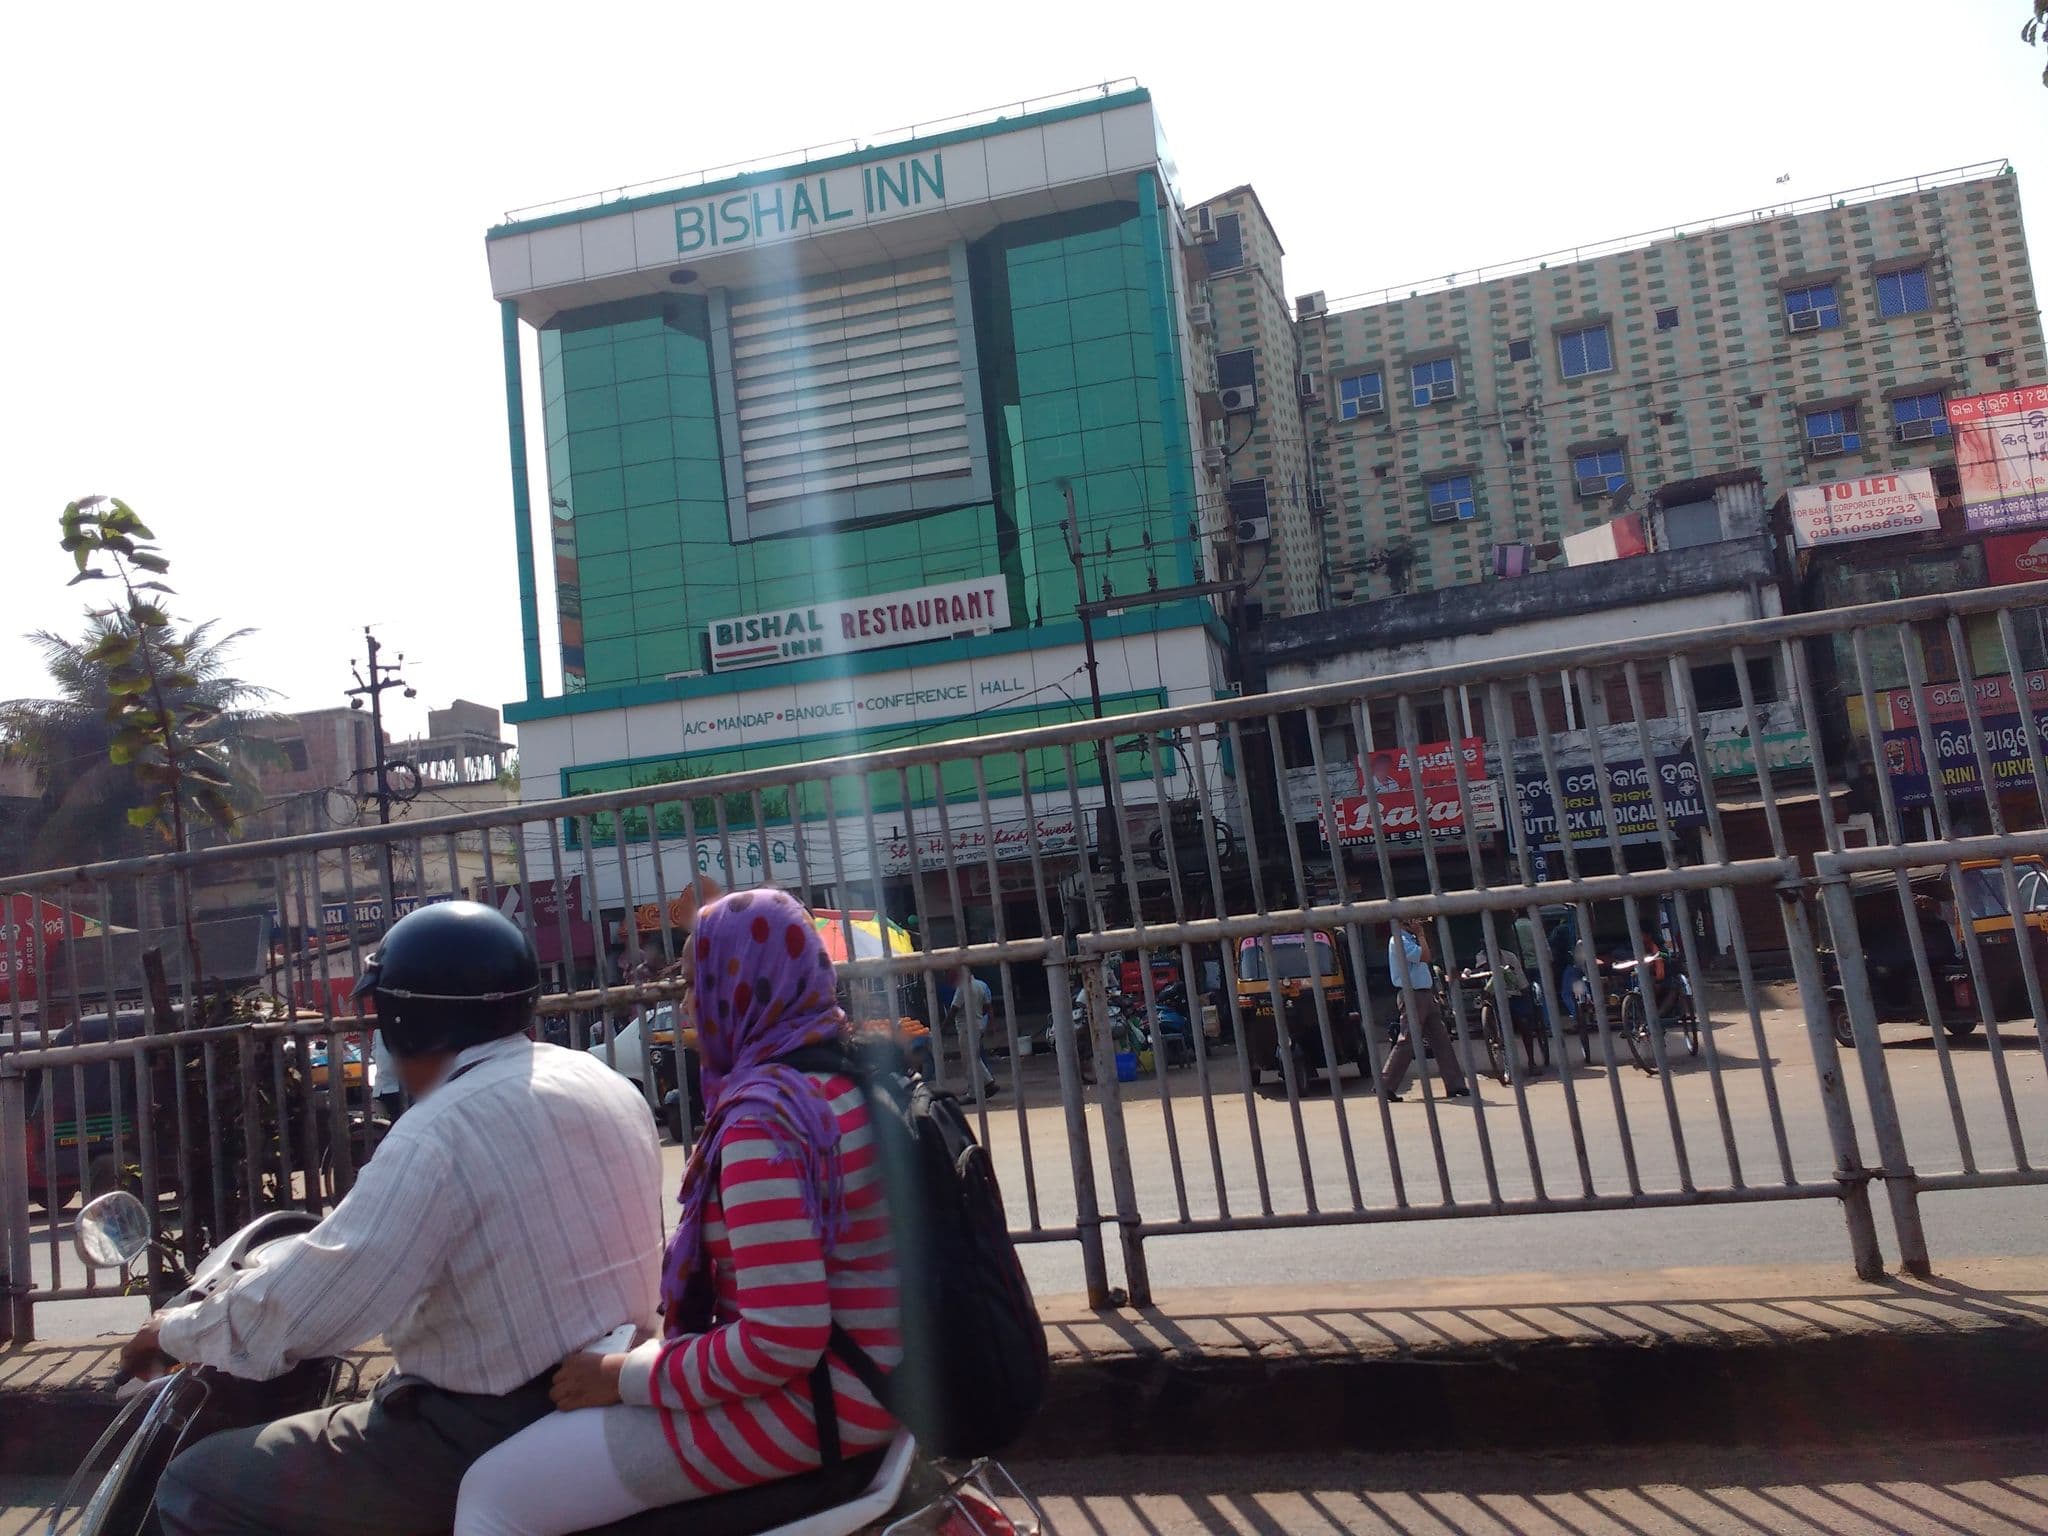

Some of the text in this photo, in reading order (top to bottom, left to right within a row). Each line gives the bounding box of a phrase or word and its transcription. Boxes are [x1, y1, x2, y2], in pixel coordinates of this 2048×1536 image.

[675, 153, 946, 253] BISHAL INN
[1819, 474, 1899, 502] TO LET
[1878, 495, 1903, 507] OFFICE
[1809, 515, 1924, 539] 09910588559
[1812, 503, 1917, 526] 9937133232
[715, 588, 996, 646] BISHAL RESTAURANT
[782, 637, 823, 657] INN
[716, 711, 774, 732] MANDAP
[785, 700, 854, 722] BANQUET
[865, 684, 969, 712] CONFERENCE
[981, 677, 1025, 695] HALL
[1397, 745, 1478, 773] Aqualie
[1941, 765, 1976, 786] ARINI
[1523, 798, 1703, 836] UTTCK MDICAL HALL
[1543, 828, 1601, 843] CHMIST
